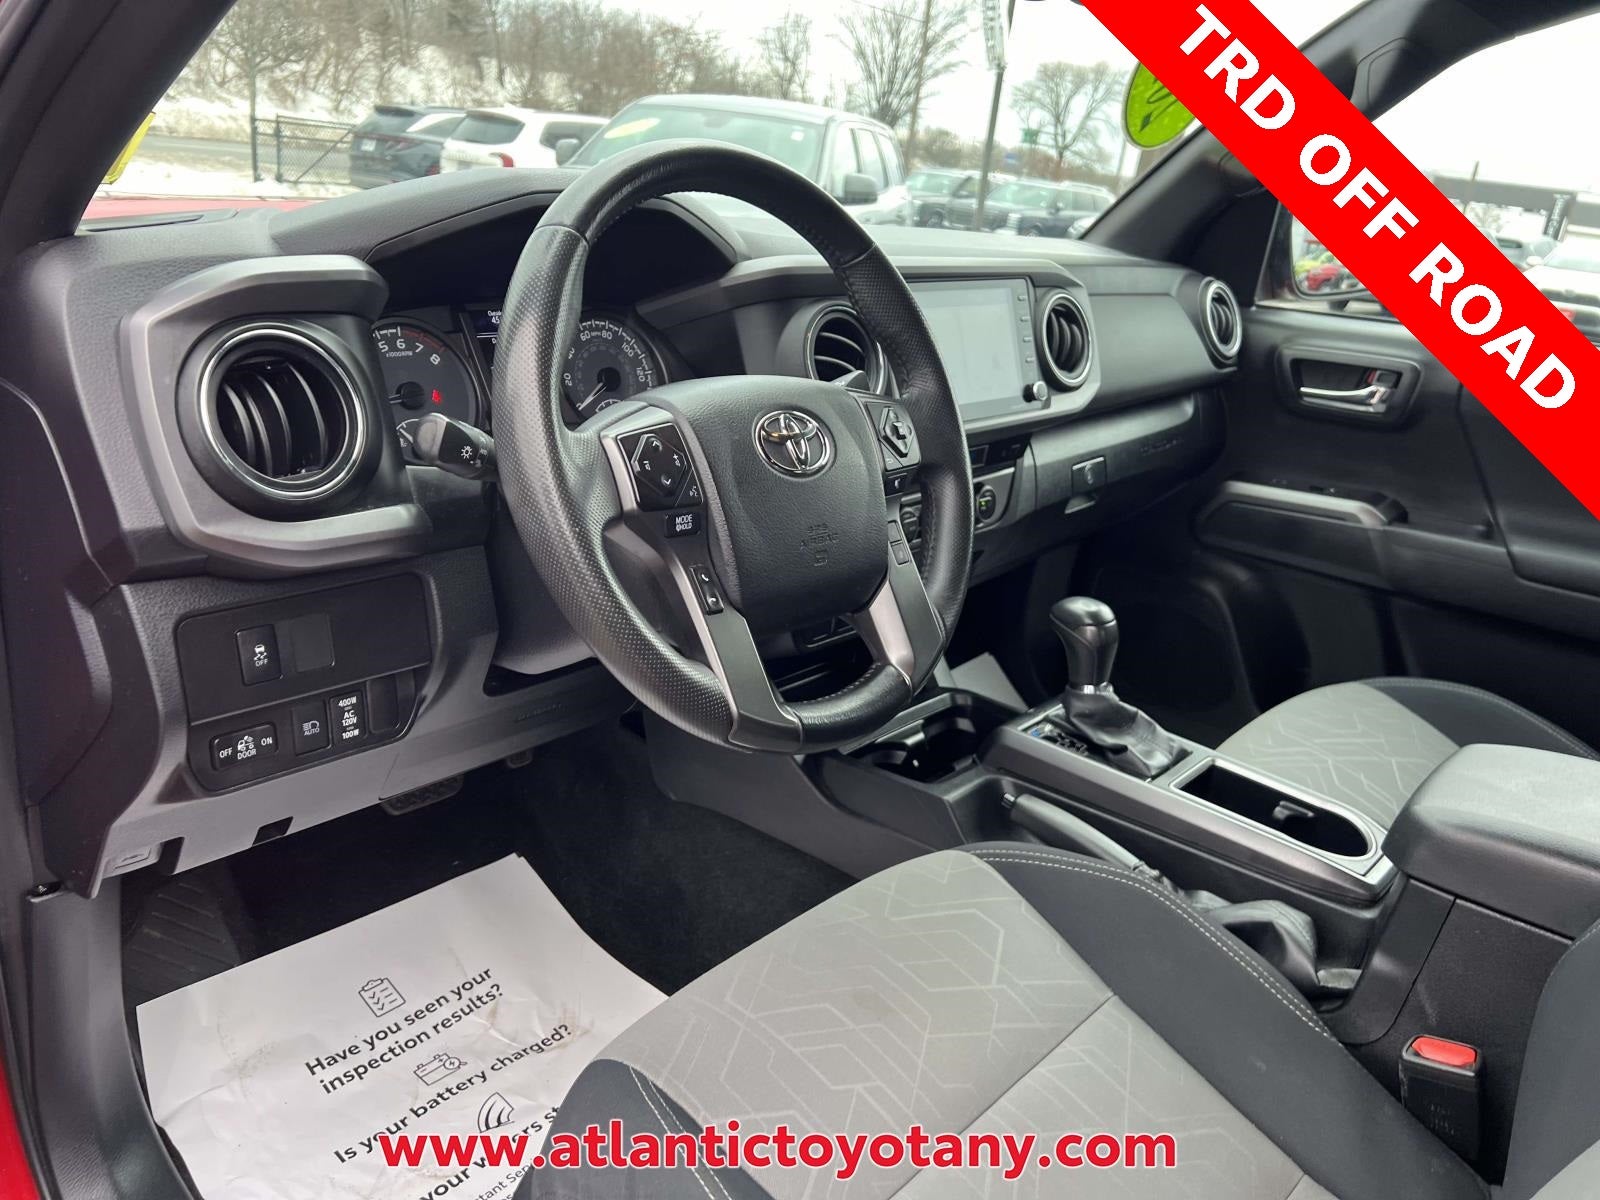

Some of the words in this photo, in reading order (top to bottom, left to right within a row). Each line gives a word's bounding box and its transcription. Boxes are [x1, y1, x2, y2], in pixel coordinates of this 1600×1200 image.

[580, 331, 591, 341] 60
[602, 330, 613, 340] 80
[378, 341, 389, 352] 5
[396, 339, 406, 349] 6
[415, 343, 424, 353] 7
[430, 354, 440, 365] 8
[621, 342, 634, 357] 100
[636, 367, 646, 382] 120
[676, 514, 693, 524] MODE
[255, 658, 268, 667] OFF
[338, 696, 357, 707] 400W
[344, 710, 355, 719] AC
[342, 716, 357, 727] 120V
[304, 727, 320, 736] AUTO
[342, 729, 360, 740] 100W
[261, 736, 273, 747] ON
[219, 748, 233, 758] OFF
[237, 749, 257, 760] DOOR
[305, 1044, 362, 1076] Have
[362, 1022, 403, 1050] you
[404, 995, 451, 1027] seen
[450, 968, 492, 1000] your
[319, 1031, 432, 1095] inspection
[432, 983, 504, 1035] results?
[333, 1146, 358, 1164] Is
[409, 1070, 488, 1119] battery
[490, 1023, 572, 1072] charged?
